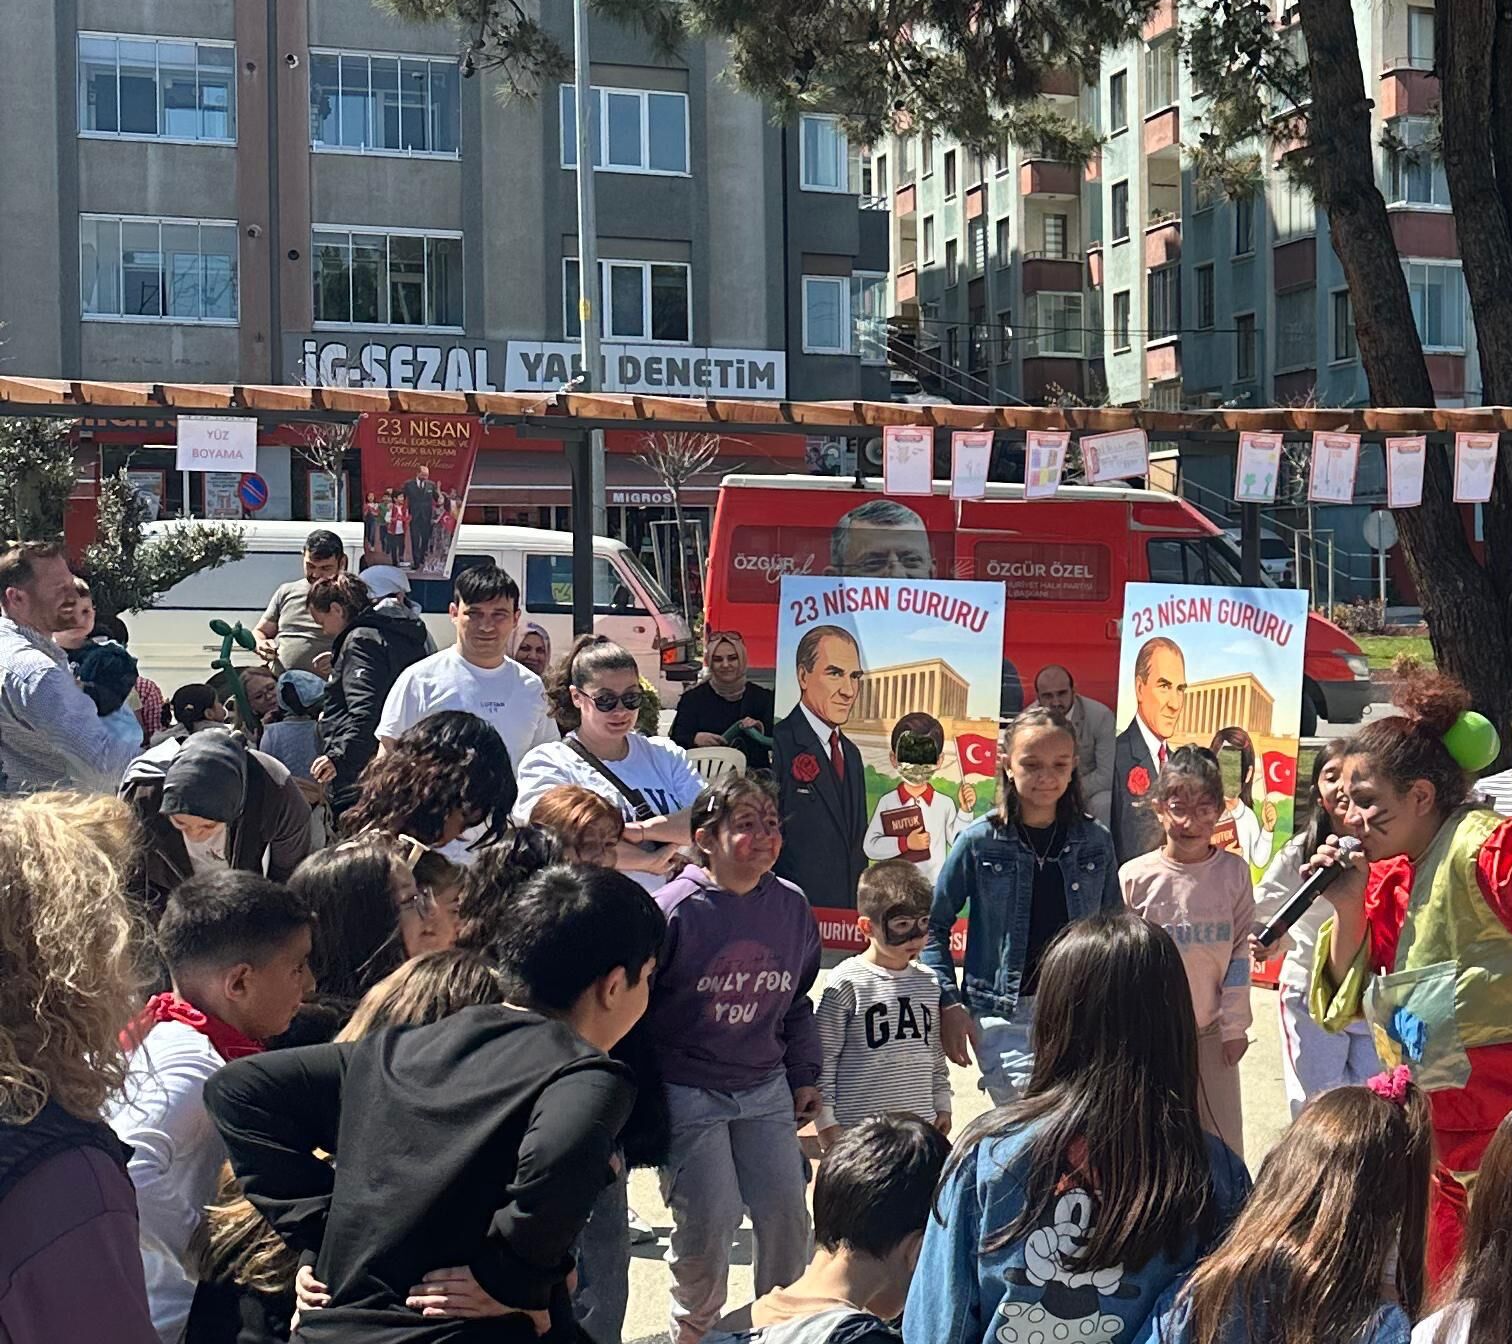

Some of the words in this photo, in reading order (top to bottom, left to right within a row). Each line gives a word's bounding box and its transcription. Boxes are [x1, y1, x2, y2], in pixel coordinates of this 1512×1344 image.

[206, 428, 230, 441] YÜZ
[377, 418, 401, 436] 23
[410, 417, 470, 439] NİSAN
[191, 447, 244, 460] BOYAMA
[986, 560, 1046, 577] ÖZGÜR
[1050, 561, 1094, 578] ÖZEL
[790, 596, 819, 626] 23
[823, 583, 890, 616] NİSAN
[897, 586, 989, 633] GURURU
[1132, 607, 1154, 638] 23
[1157, 594, 1213, 628] NİSAN
[1217, 598, 1294, 647] GURURU
[891, 815, 920, 831] NUTUK
[696, 972, 751, 993] ONLY
[753, 970, 792, 993] FOR
[715, 1001, 759, 1025] YOU
[865, 997, 932, 1049] GAP
